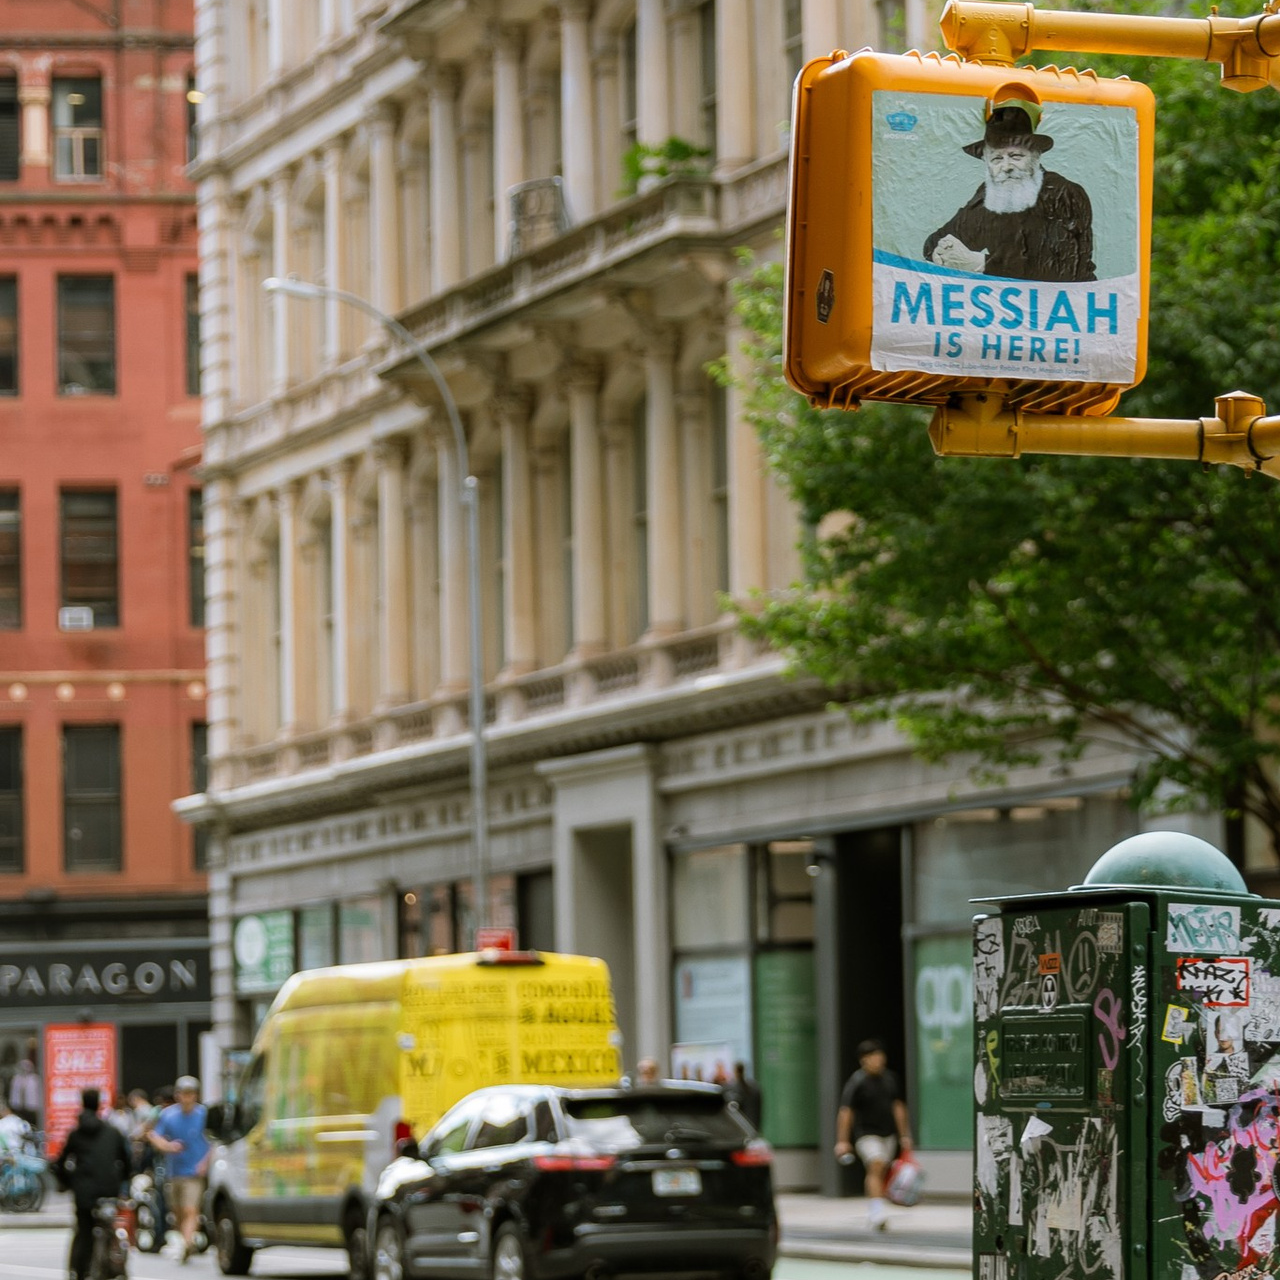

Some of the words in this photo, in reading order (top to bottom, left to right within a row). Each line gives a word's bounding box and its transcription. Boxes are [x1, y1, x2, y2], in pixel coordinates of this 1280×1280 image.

[891, 281, 1118, 335] MESSIAH
[933, 331, 963, 358] IS
[981, 334, 1080, 364] HERE!
[0, 959, 197, 997] PARAGON
